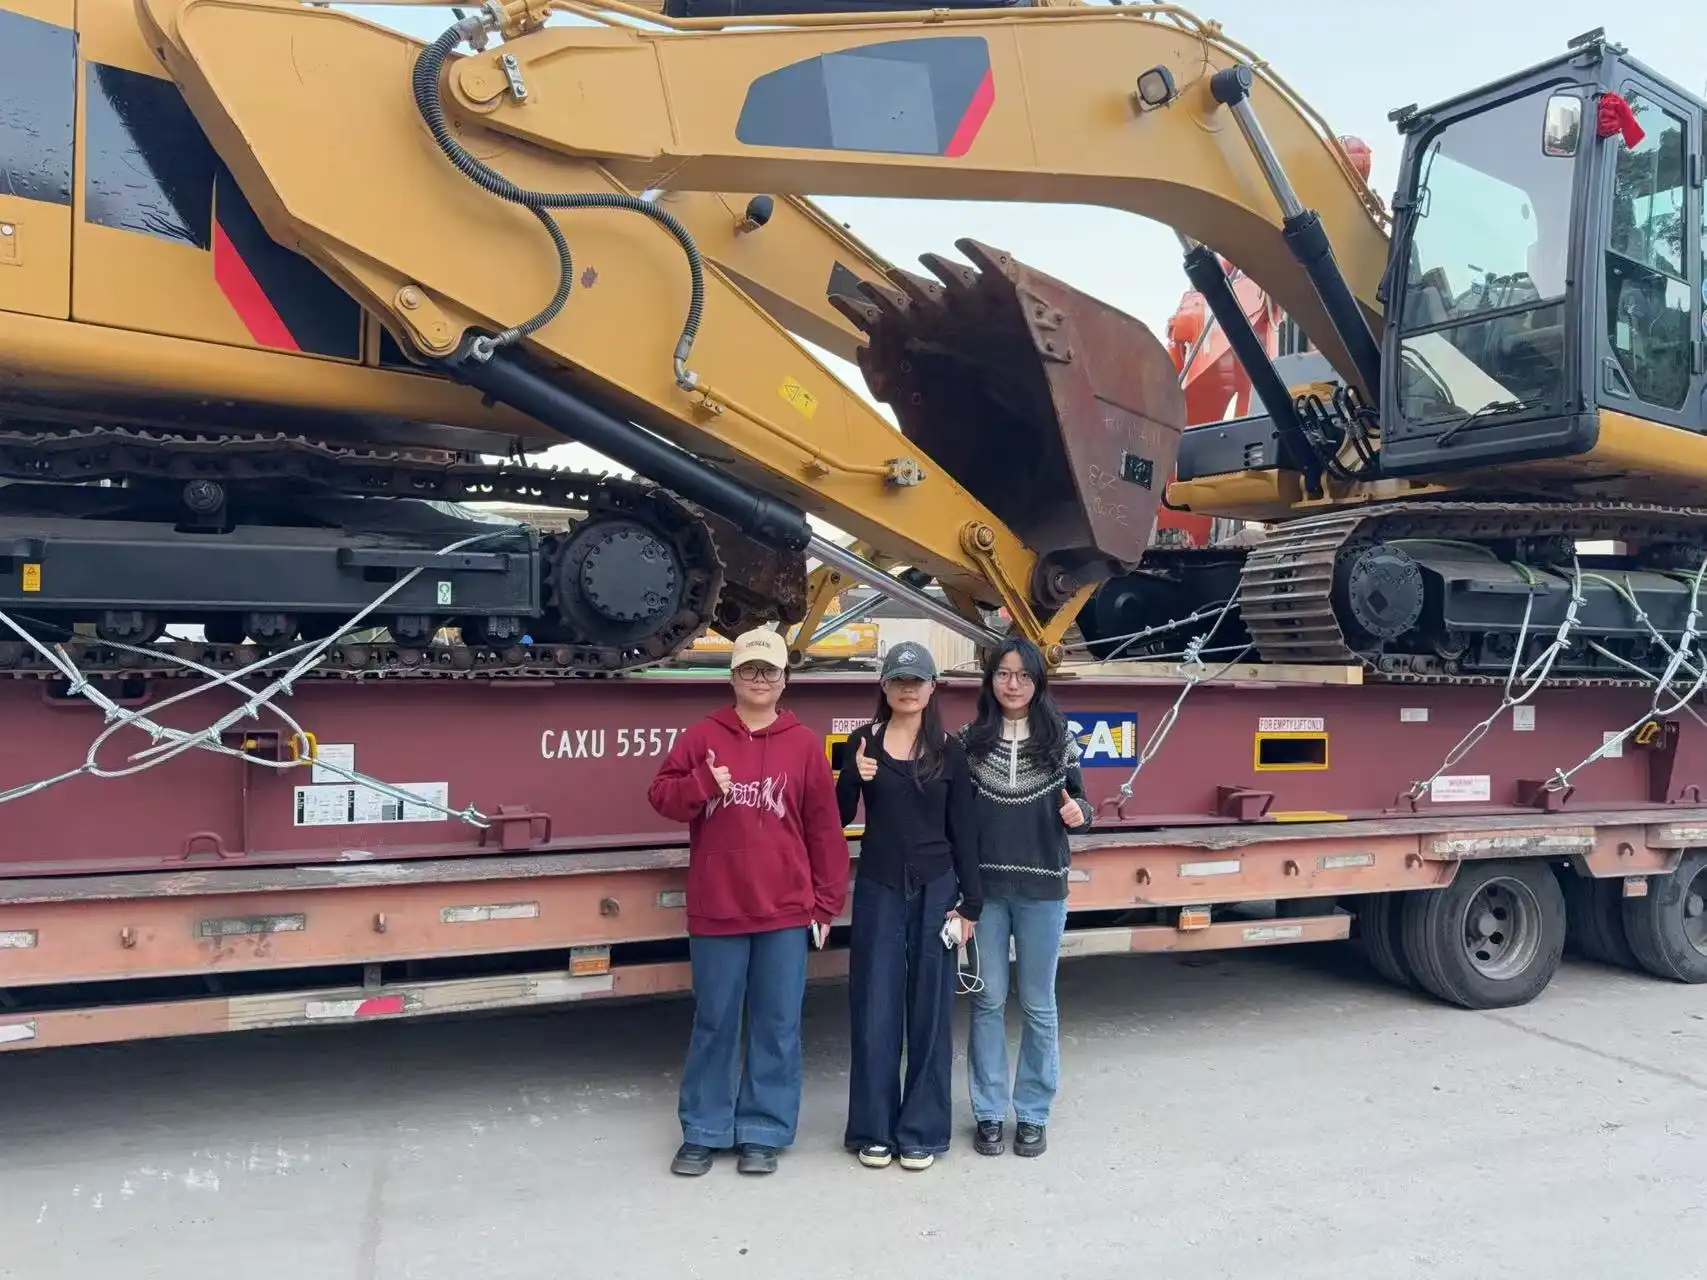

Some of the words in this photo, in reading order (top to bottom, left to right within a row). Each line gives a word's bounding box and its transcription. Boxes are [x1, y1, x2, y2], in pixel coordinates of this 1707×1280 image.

[833, 720, 849, 732] FOR
[1260, 719, 1273, 730] FOR
[1274, 719, 1294, 730] EMPTY
[1308, 719, 1323, 730] ONLY
[541, 729, 605, 759] CAXU
[617, 728, 687, 757] 5557
